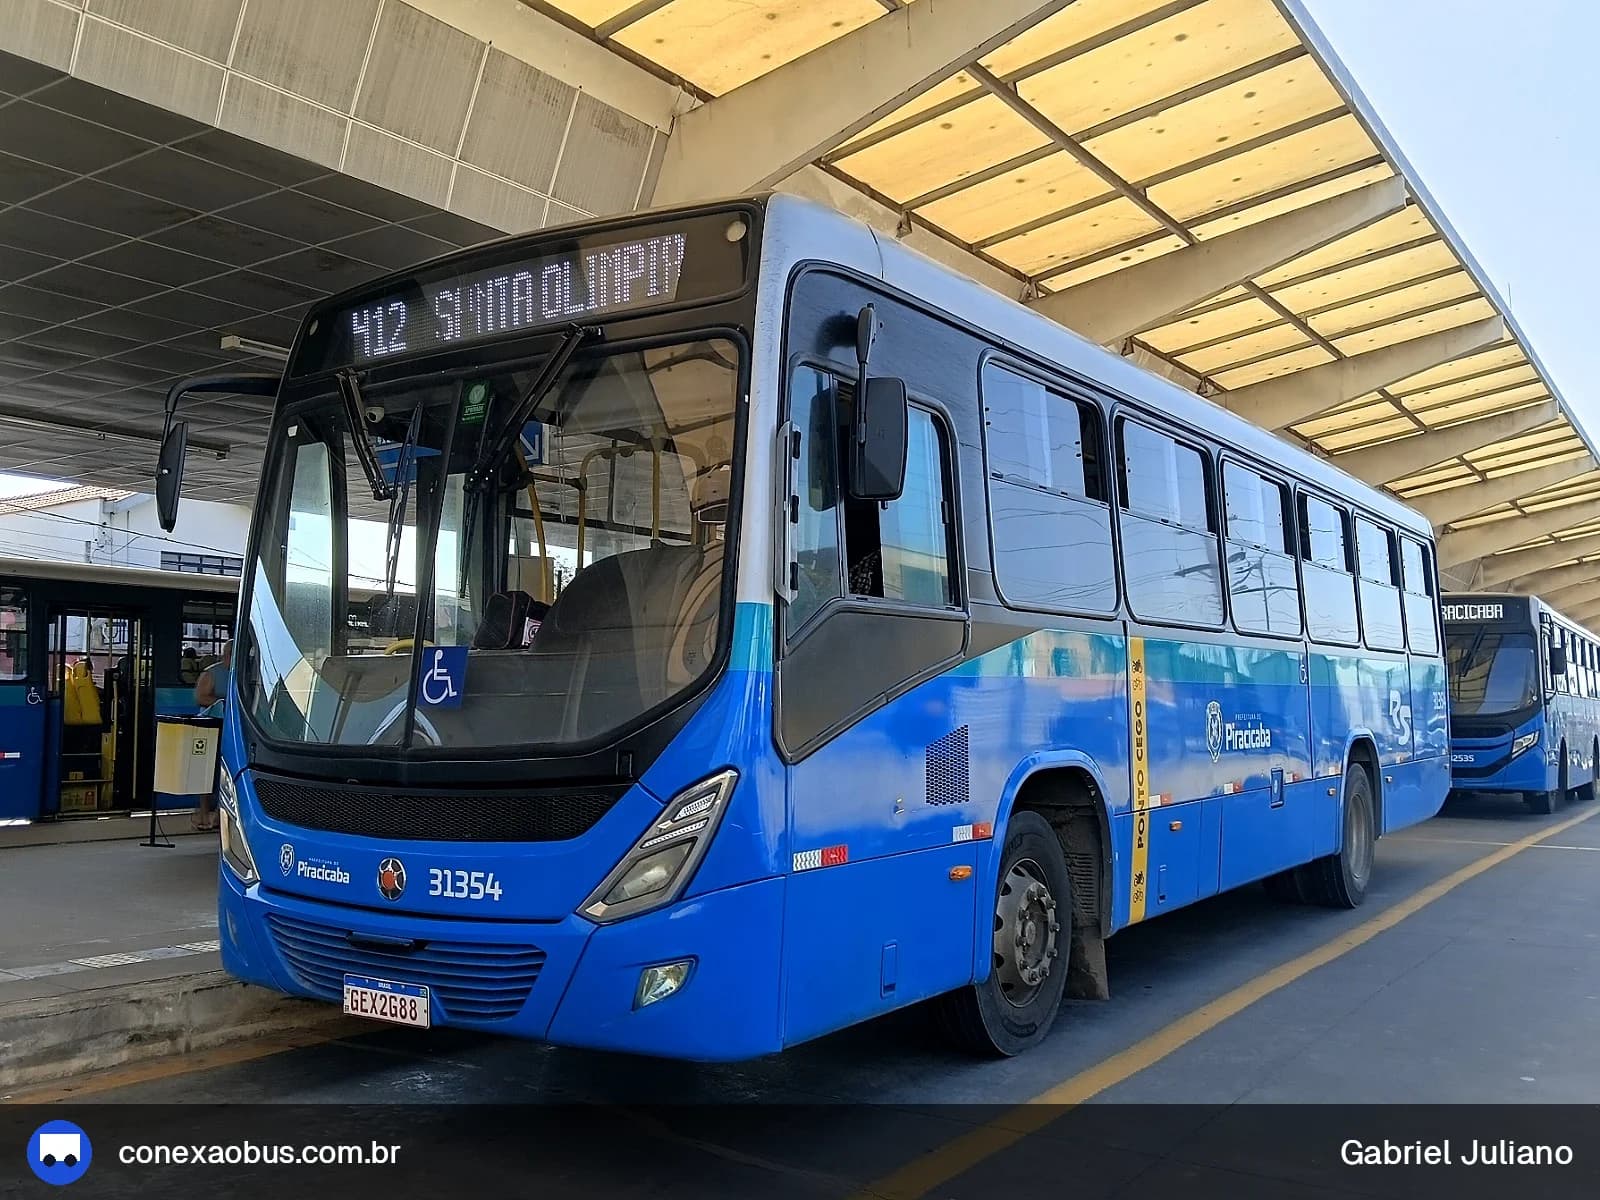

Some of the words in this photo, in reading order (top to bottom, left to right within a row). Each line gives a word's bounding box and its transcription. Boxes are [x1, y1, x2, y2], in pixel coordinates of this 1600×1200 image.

[352, 302, 407, 357] 412
[1135, 700, 1144, 762] CEGO
[1225, 721, 1271, 751] Piracicaba
[1136, 769, 1145, 849] PONTO
[297, 860, 351, 885] Piracicaba
[428, 868, 504, 902] 31354
[350, 989, 418, 1021] GEX2G88
